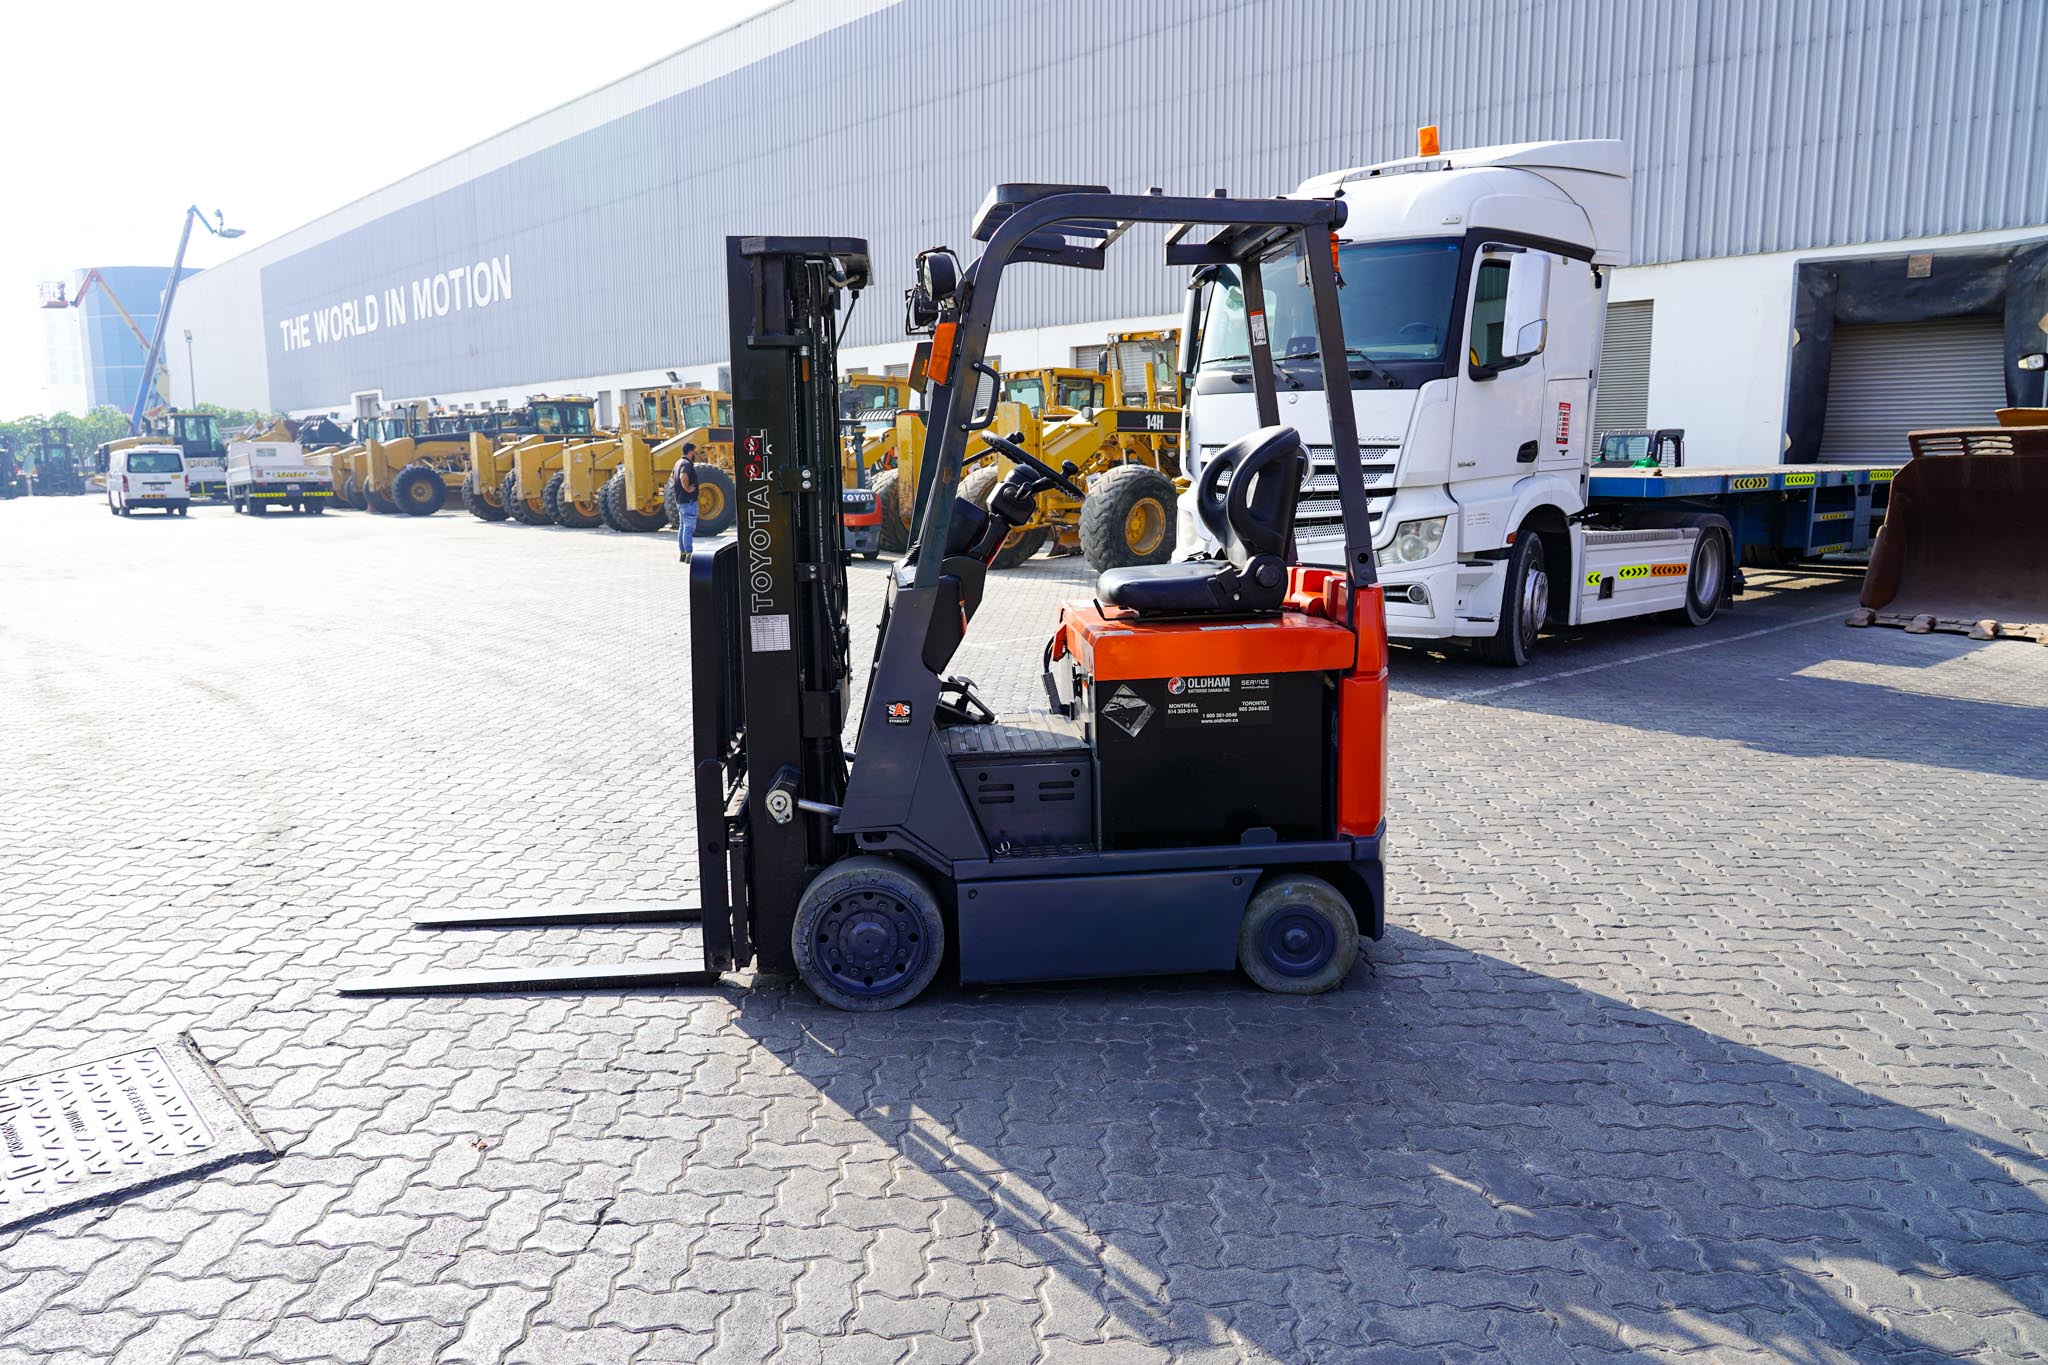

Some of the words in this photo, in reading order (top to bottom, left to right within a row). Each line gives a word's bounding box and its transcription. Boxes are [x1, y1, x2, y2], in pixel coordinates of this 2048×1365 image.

[280, 313, 311, 352] THE
[313, 294, 379, 345] WORLD
[384, 285, 407, 328] IN
[412, 254, 512, 321] MOTION
[1145, 414, 1164, 430] 14H
[842, 494, 874, 502] TOYOTA
[748, 484, 774, 613] TOYOTA
[1187, 677, 1231, 688] OLDHAM
[888, 702, 911, 717] SAS
